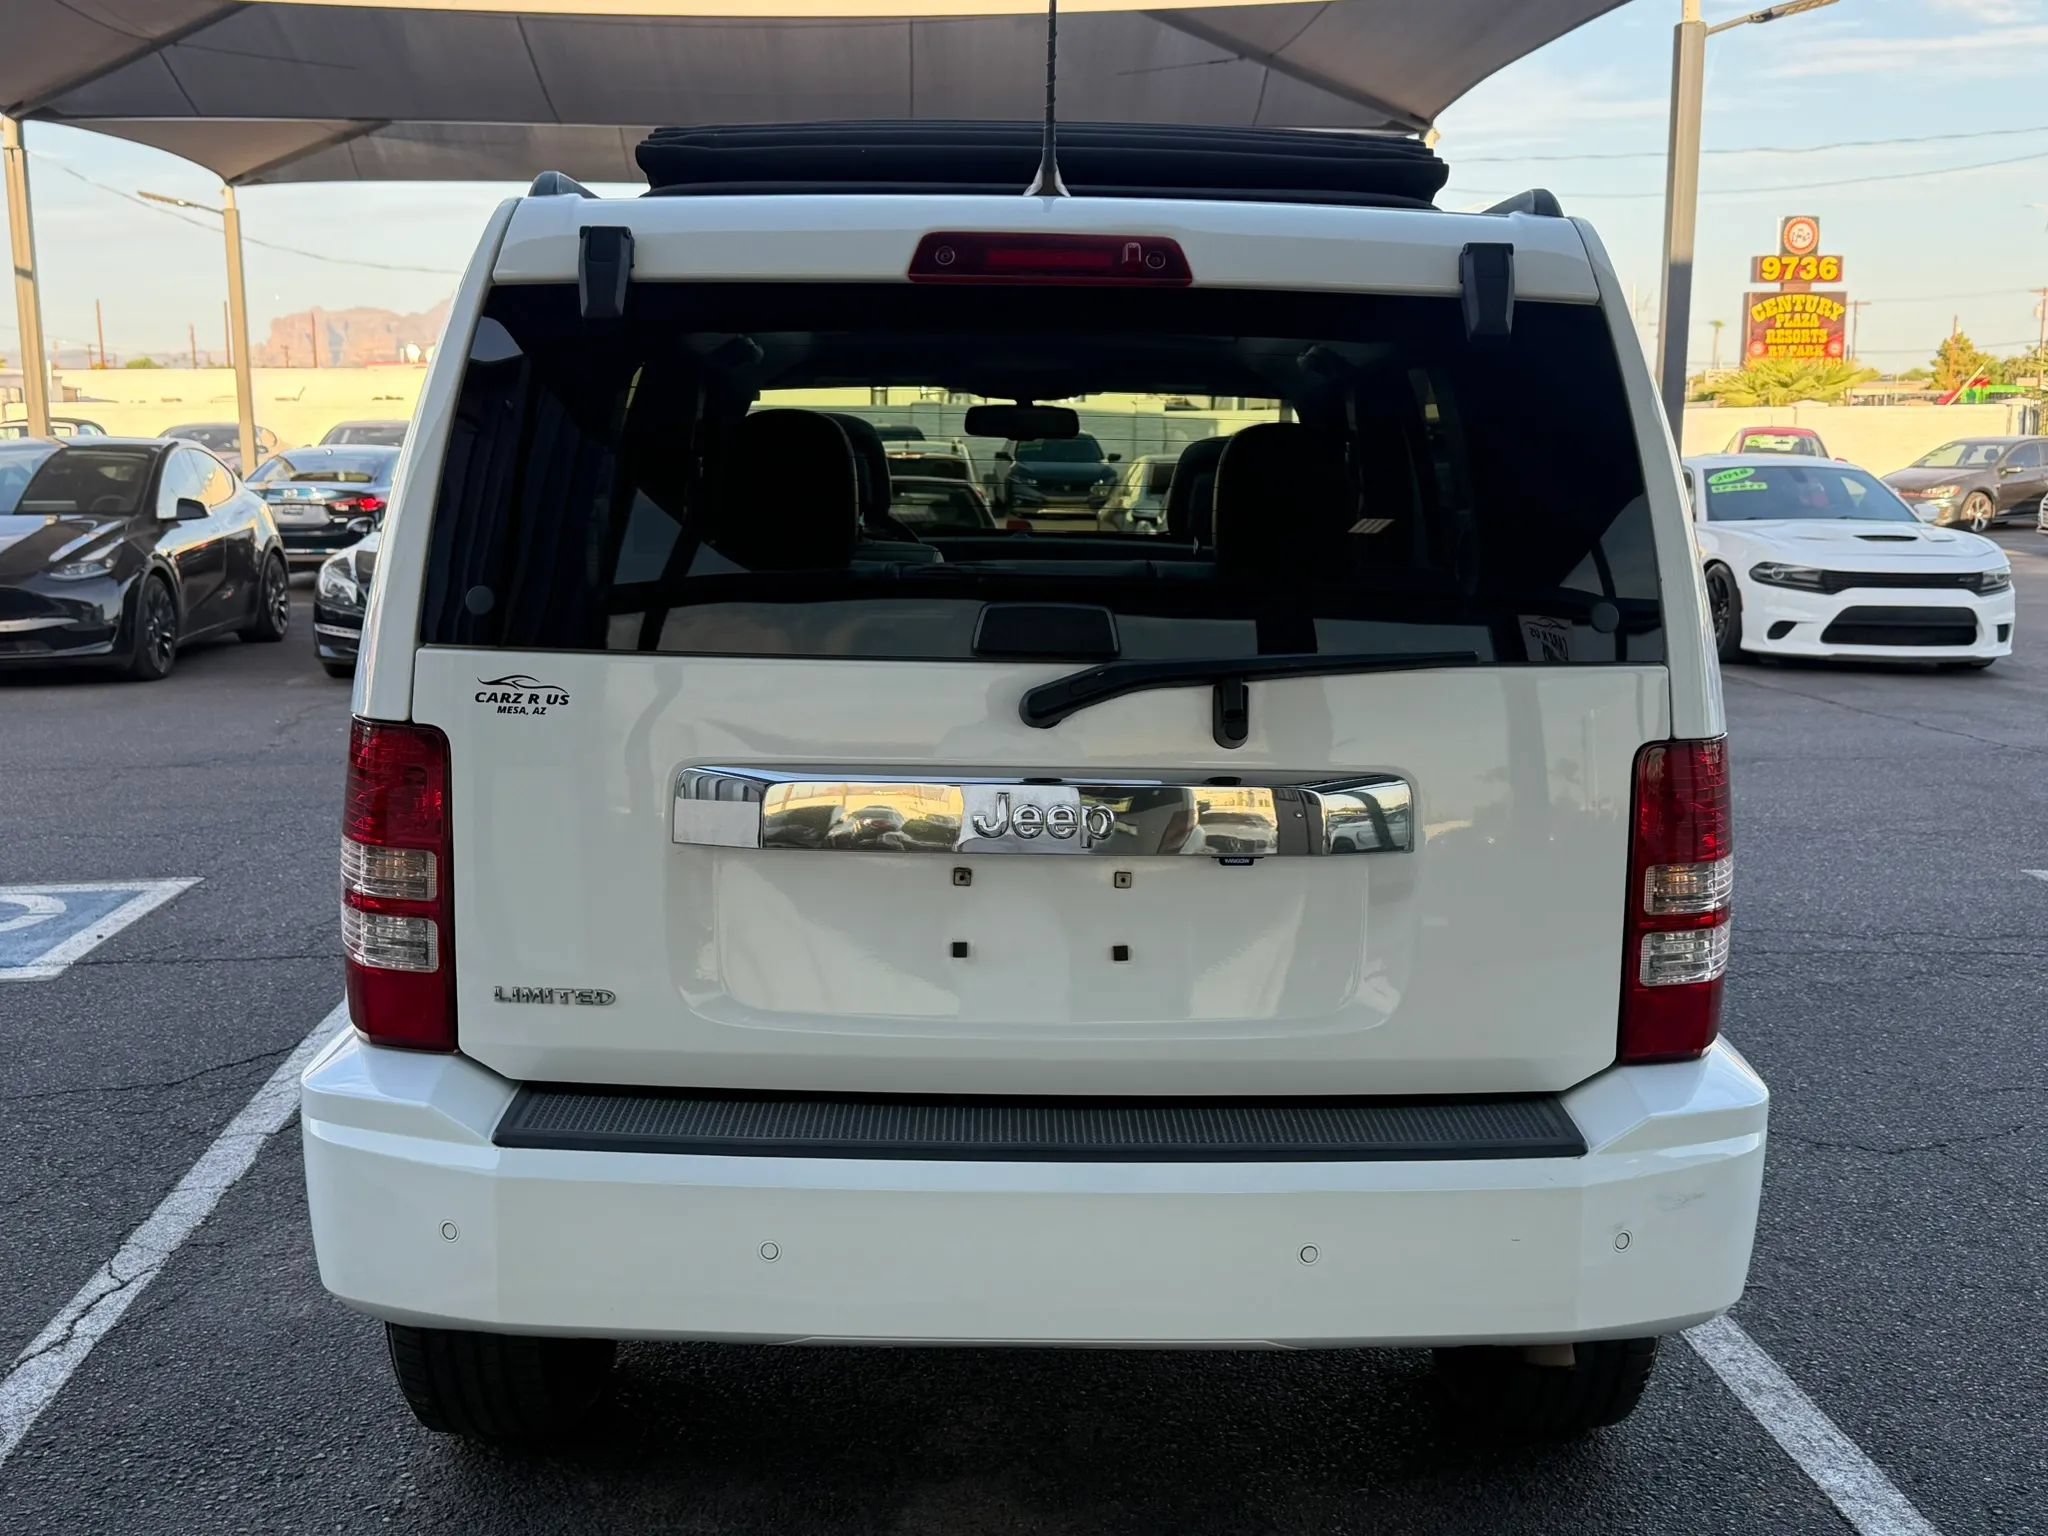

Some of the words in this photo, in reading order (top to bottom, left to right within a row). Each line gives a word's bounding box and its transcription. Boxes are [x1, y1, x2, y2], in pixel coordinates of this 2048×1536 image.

[1761, 256, 1838, 281] 9736
[1751, 294, 1845, 322] CENTURY
[1775, 313, 1820, 328] PLAZA
[1765, 329, 1828, 344] RESORTS
[1789, 345, 1825, 357] PARK
[474, 691, 524, 704] CARZ
[527, 693, 540, 705] R
[546, 694, 570, 706] US
[496, 705, 529, 716] MESA,
[532, 706, 547, 715] AZ
[972, 792, 1116, 849] Jeep
[494, 985, 617, 1006] LIMITED
